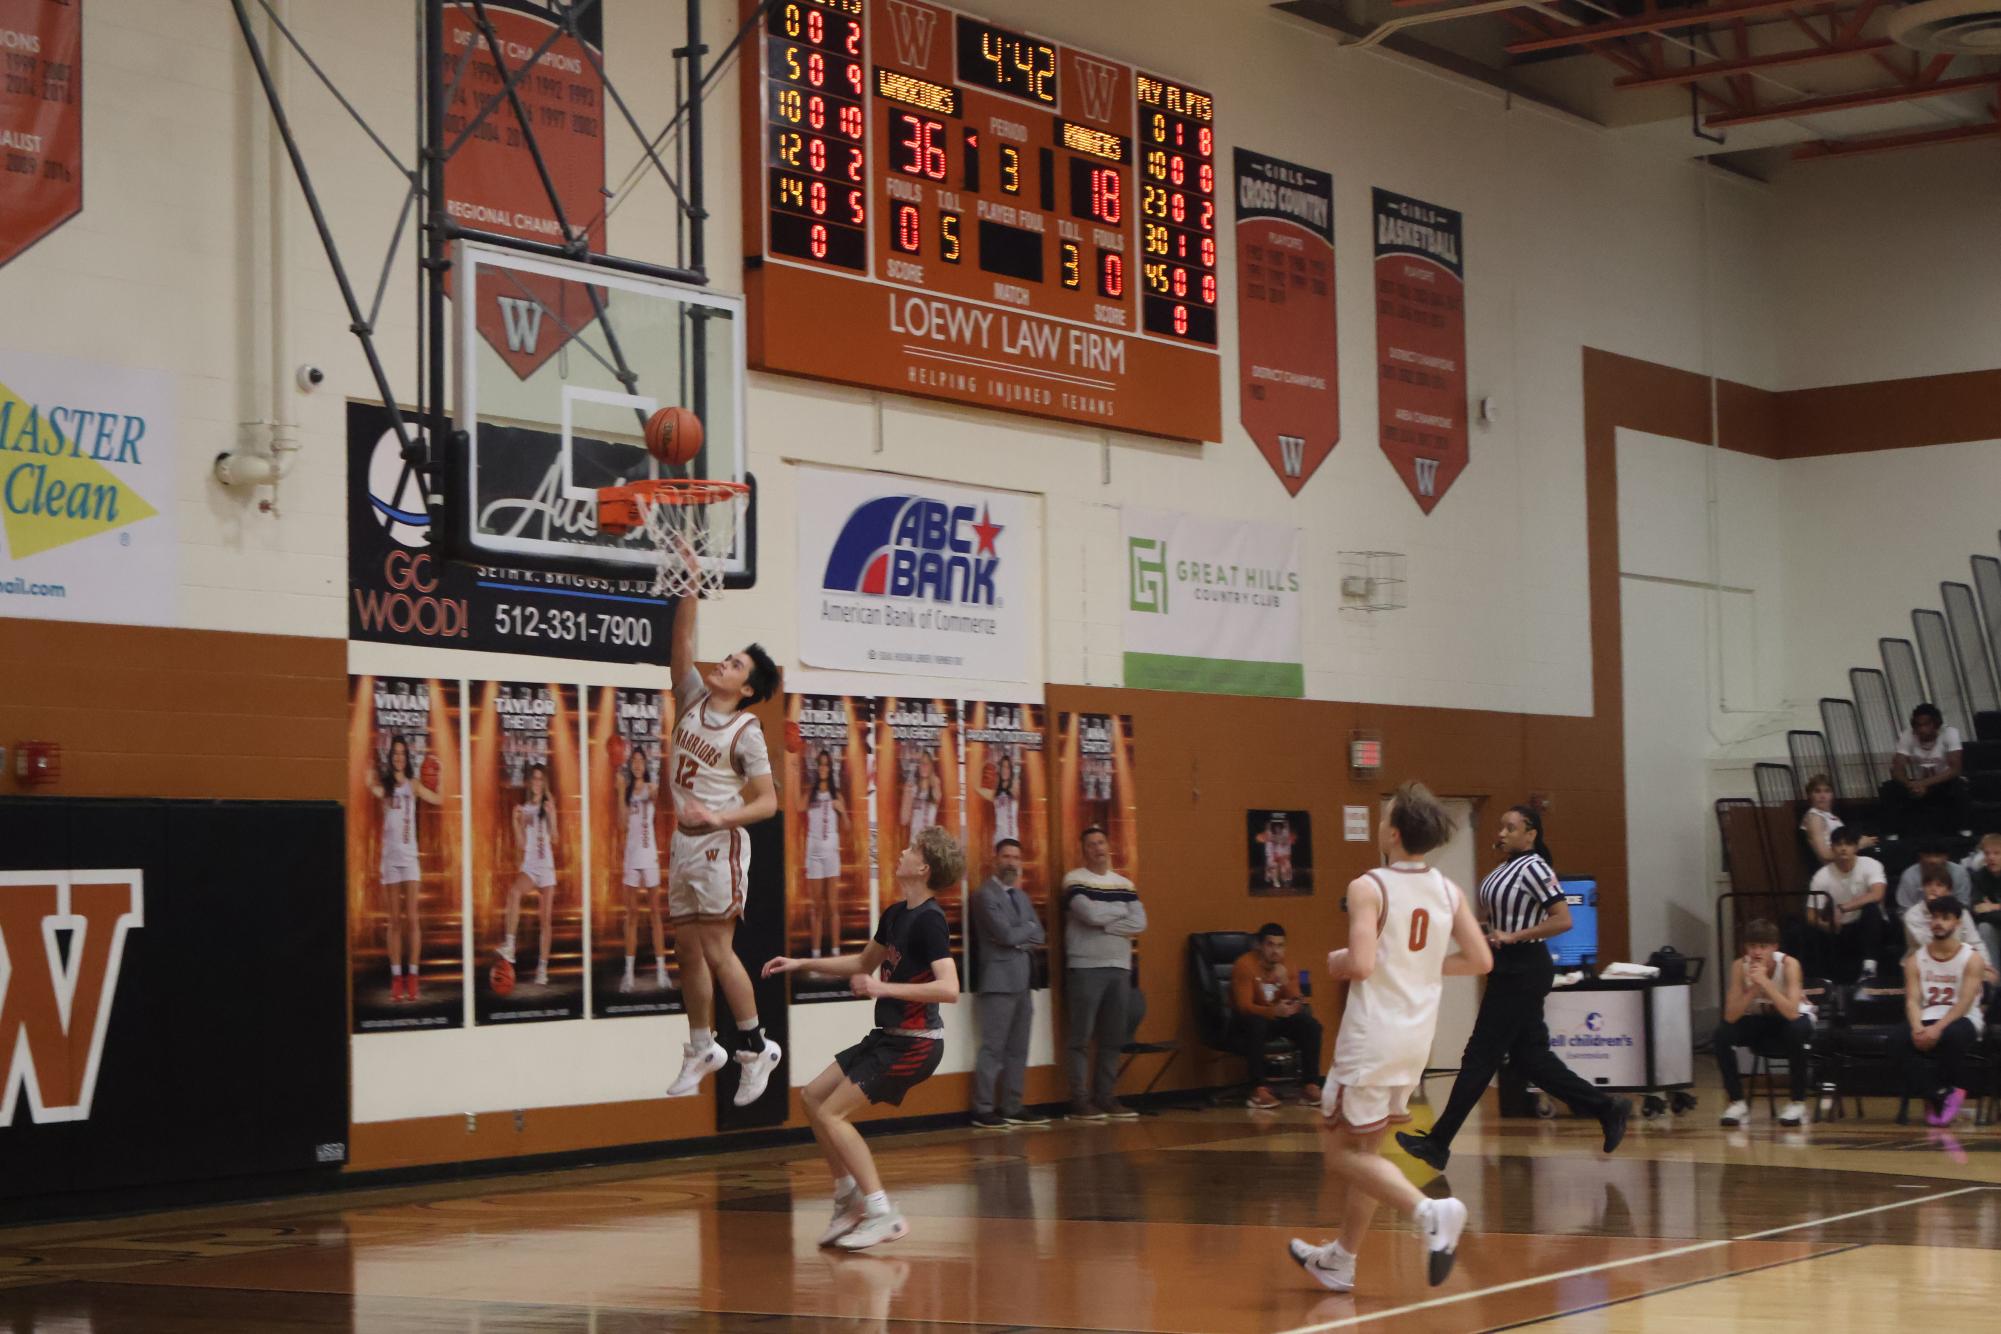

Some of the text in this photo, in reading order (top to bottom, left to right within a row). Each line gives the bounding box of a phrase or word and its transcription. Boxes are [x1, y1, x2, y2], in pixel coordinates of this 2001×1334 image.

[786, 4, 799, 36] 0
[808, 11, 823, 43] 0
[846, 22, 860, 54] 2
[886, 1, 937, 70] W
[786, 47, 861, 94] 5 0 9
[982, 32, 1055, 101] 4:42
[1074, 56, 1118, 123] W
[1186, 92, 1212, 120] PTS
[778, 90, 862, 139] 10 0 10
[990, 117, 1028, 142] PERIOD
[1154, 114, 1212, 156] 0 1 8
[779, 133, 863, 181] 12 0 2
[902, 115, 946, 178] 36
[886, 178, 922, 202] FOULS
[1004, 149, 1019, 192] 3
[1148, 151, 1213, 193] 10 0 0
[1265, 163, 1304, 186] GIRLS
[447, 200, 511, 228] REGIONAL
[780, 177, 864, 223] 14 0 5
[977, 200, 1016, 225] PLAYER
[1091, 169, 1121, 224] 18
[1143, 185, 1213, 230] 23 0 2
[1240, 176, 1329, 229] CROSS COUNTRY
[1402, 202, 1436, 224] GIRLS
[811, 225, 827, 258] 0
[900, 206, 920, 250] 0
[943, 216, 960, 259] 5
[1093, 228, 1124, 251] FOULS
[1145, 223, 1215, 267] 30 1 0
[1378, 213, 1459, 265] BASKETBALL
[887, 258, 924, 283] SCORE
[1064, 243, 1080, 286] 3
[1105, 254, 1123, 296] 0
[1144, 263, 1216, 304] 45 0 0
[994, 282, 1030, 306] MATCH
[1094, 304, 1126, 326] SCORE
[496, 296, 543, 355] W
[889, 293, 1125, 374] LOEWY LAW FIRM
[1174, 305, 1188, 335] 0
[908, 366, 1114, 416] HELPING INJURED TEXANS
[1278, 435, 1305, 477] W
[1415, 457, 1440, 496] W
[4, 463, 119, 522] Clean
[896, 501, 976, 554] ABC
[0, 577, 66, 598] ail.com
[891, 548, 1000, 606] BANK
[1177, 560, 1300, 592] GREAT HILLS
[354, 588, 469, 638] WOOD!
[821, 600, 997, 635] American Bank of Commerce
[1194, 588, 1281, 608] COUNTRY CLUB
[495, 604, 652, 648] 512-331-7900
[494, 698, 557, 715] TAYLOR
[884, 711, 949, 727] CAROLINE
[675, 727, 722, 767] WARRIORS
[675, 753, 700, 790] 12
[1408, 907, 1430, 953] 0
[1928, 986, 1954, 1006] 22
[1549, 1033, 1633, 1047] ell children's
